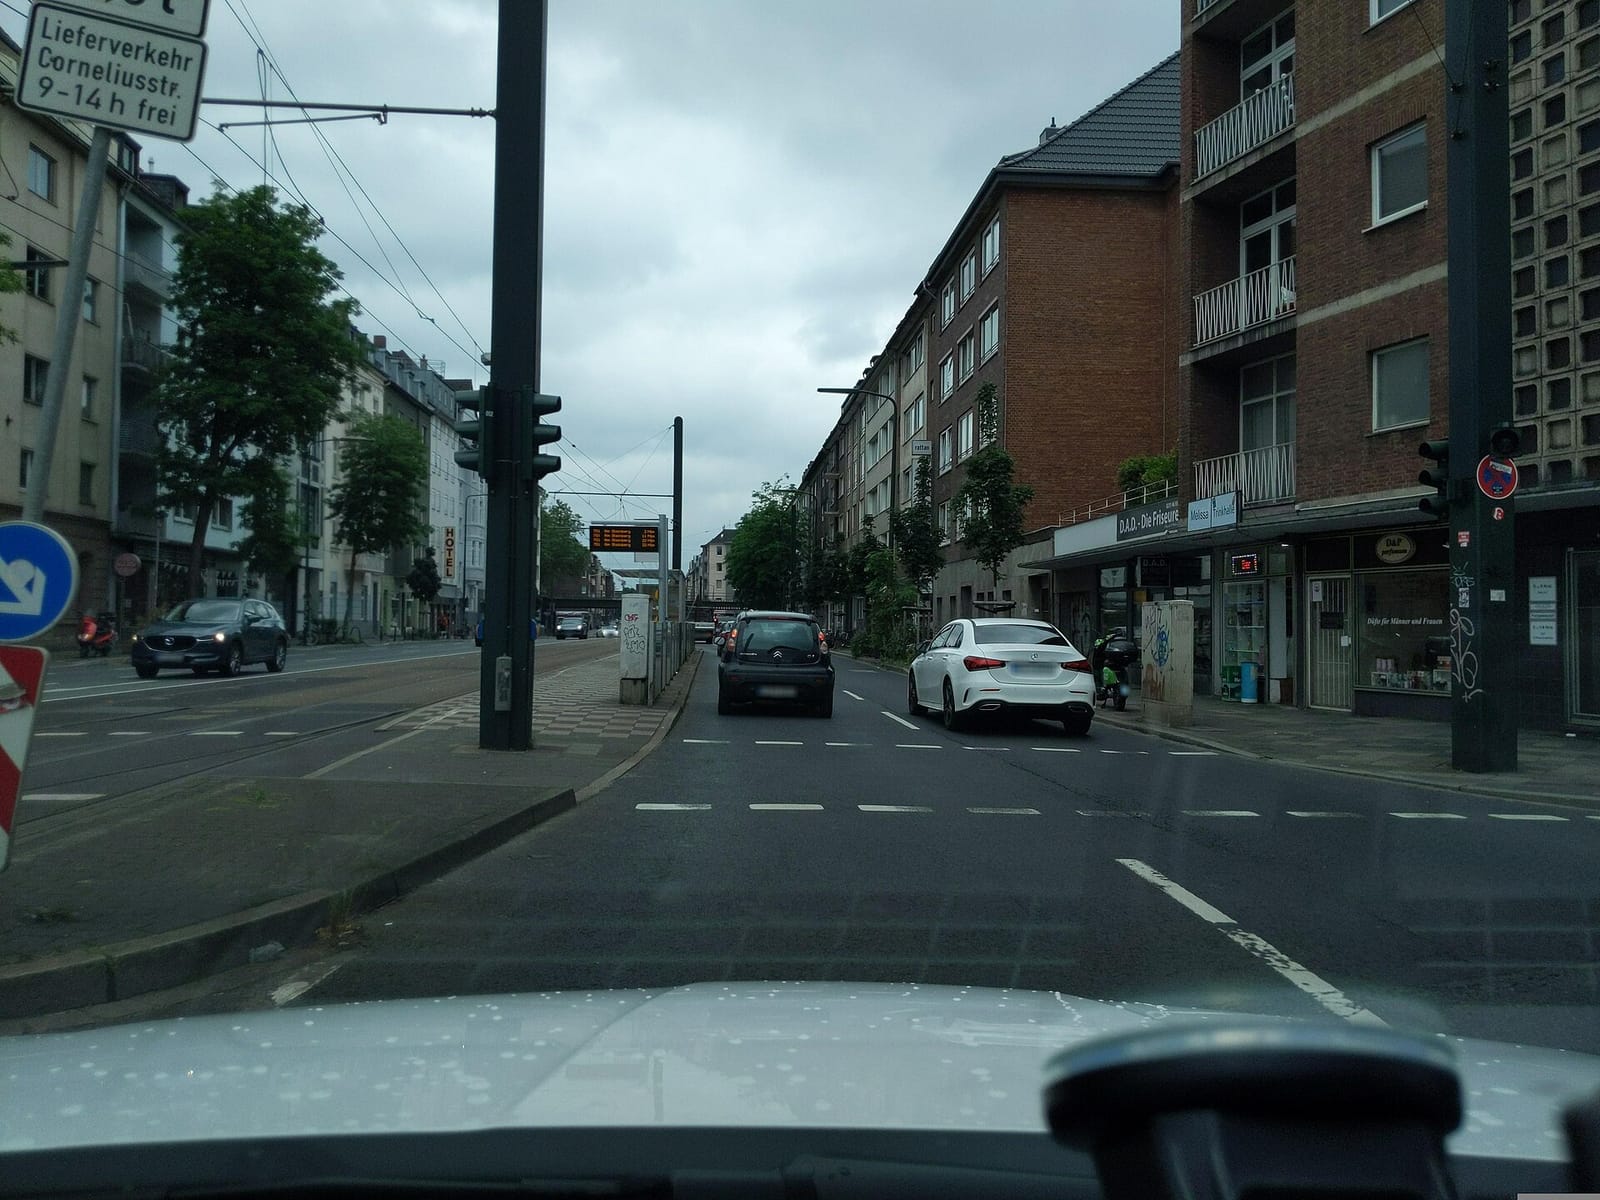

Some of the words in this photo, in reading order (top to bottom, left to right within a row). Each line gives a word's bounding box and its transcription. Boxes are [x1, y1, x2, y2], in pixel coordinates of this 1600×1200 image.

[41, 16, 193, 72] Lieferverkehr
[38, 46, 181, 99] Corneliusstr.
[109, 92, 125, 116] h
[138, 99, 177, 126] frei
[1120, 517, 1138, 534] D.A.D.
[1141, 513, 1152, 529] Die
[1152, 509, 1179, 527] Friseure
[446, 528, 454, 577] HOTEL
